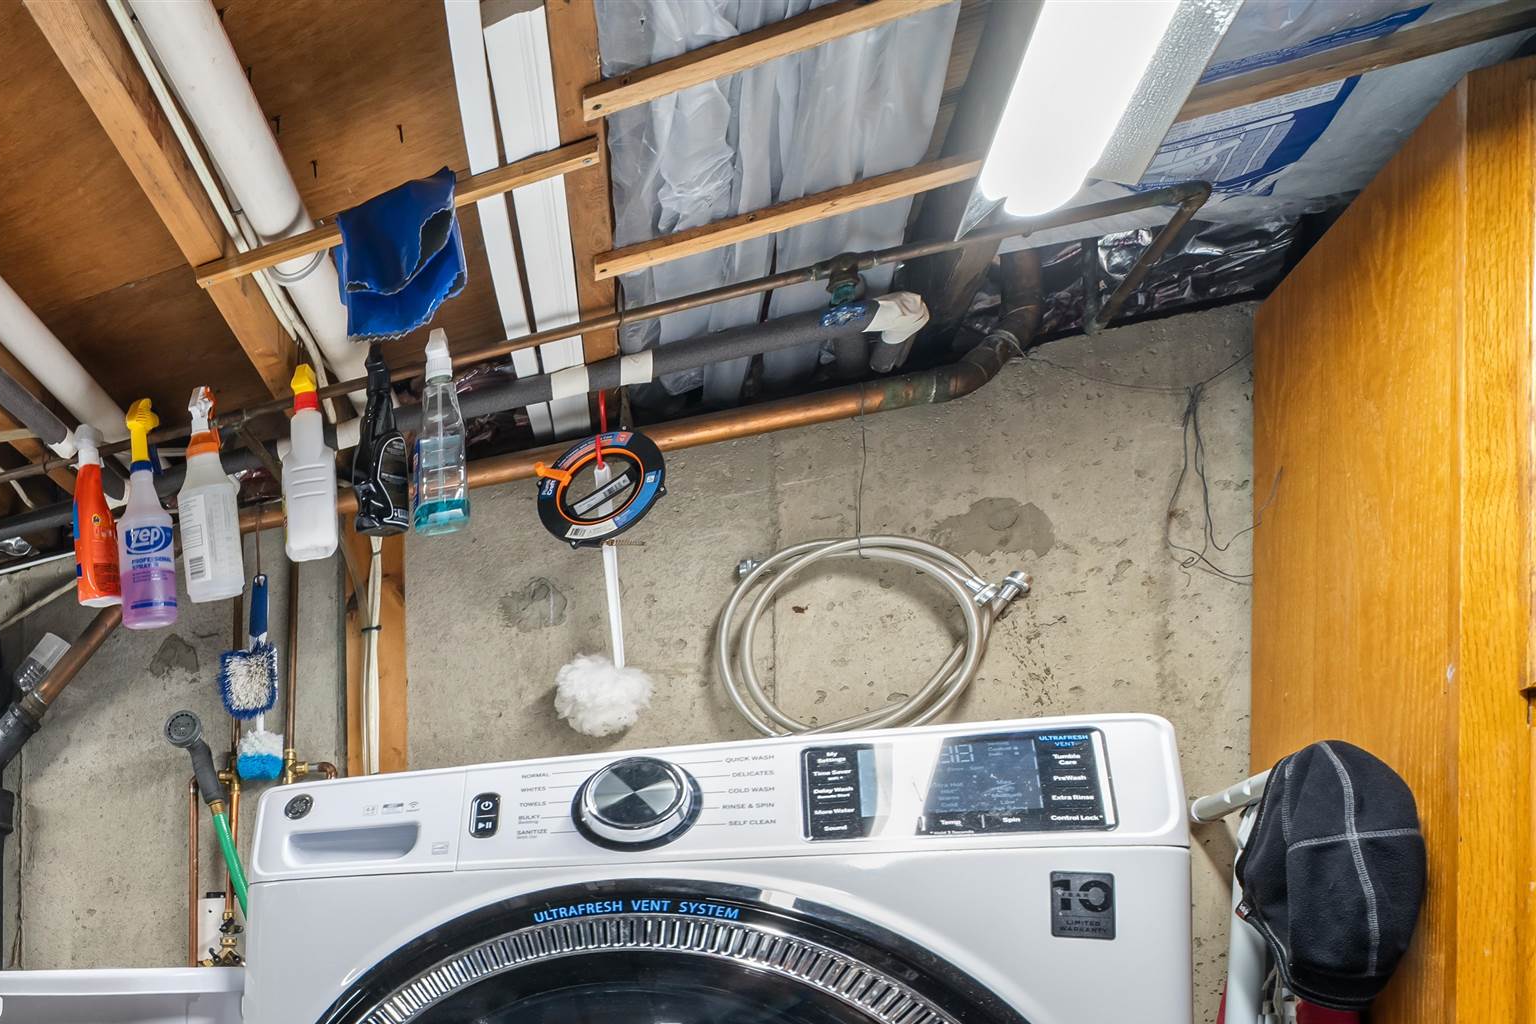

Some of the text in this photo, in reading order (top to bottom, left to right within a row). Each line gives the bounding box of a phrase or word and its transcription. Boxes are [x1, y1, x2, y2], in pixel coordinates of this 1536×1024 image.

[724, 756, 750, 764] QUICK
[731, 769, 776, 778] DELICATES
[533, 899, 740, 923] ULTRAFRESH VENT SYSTEM
